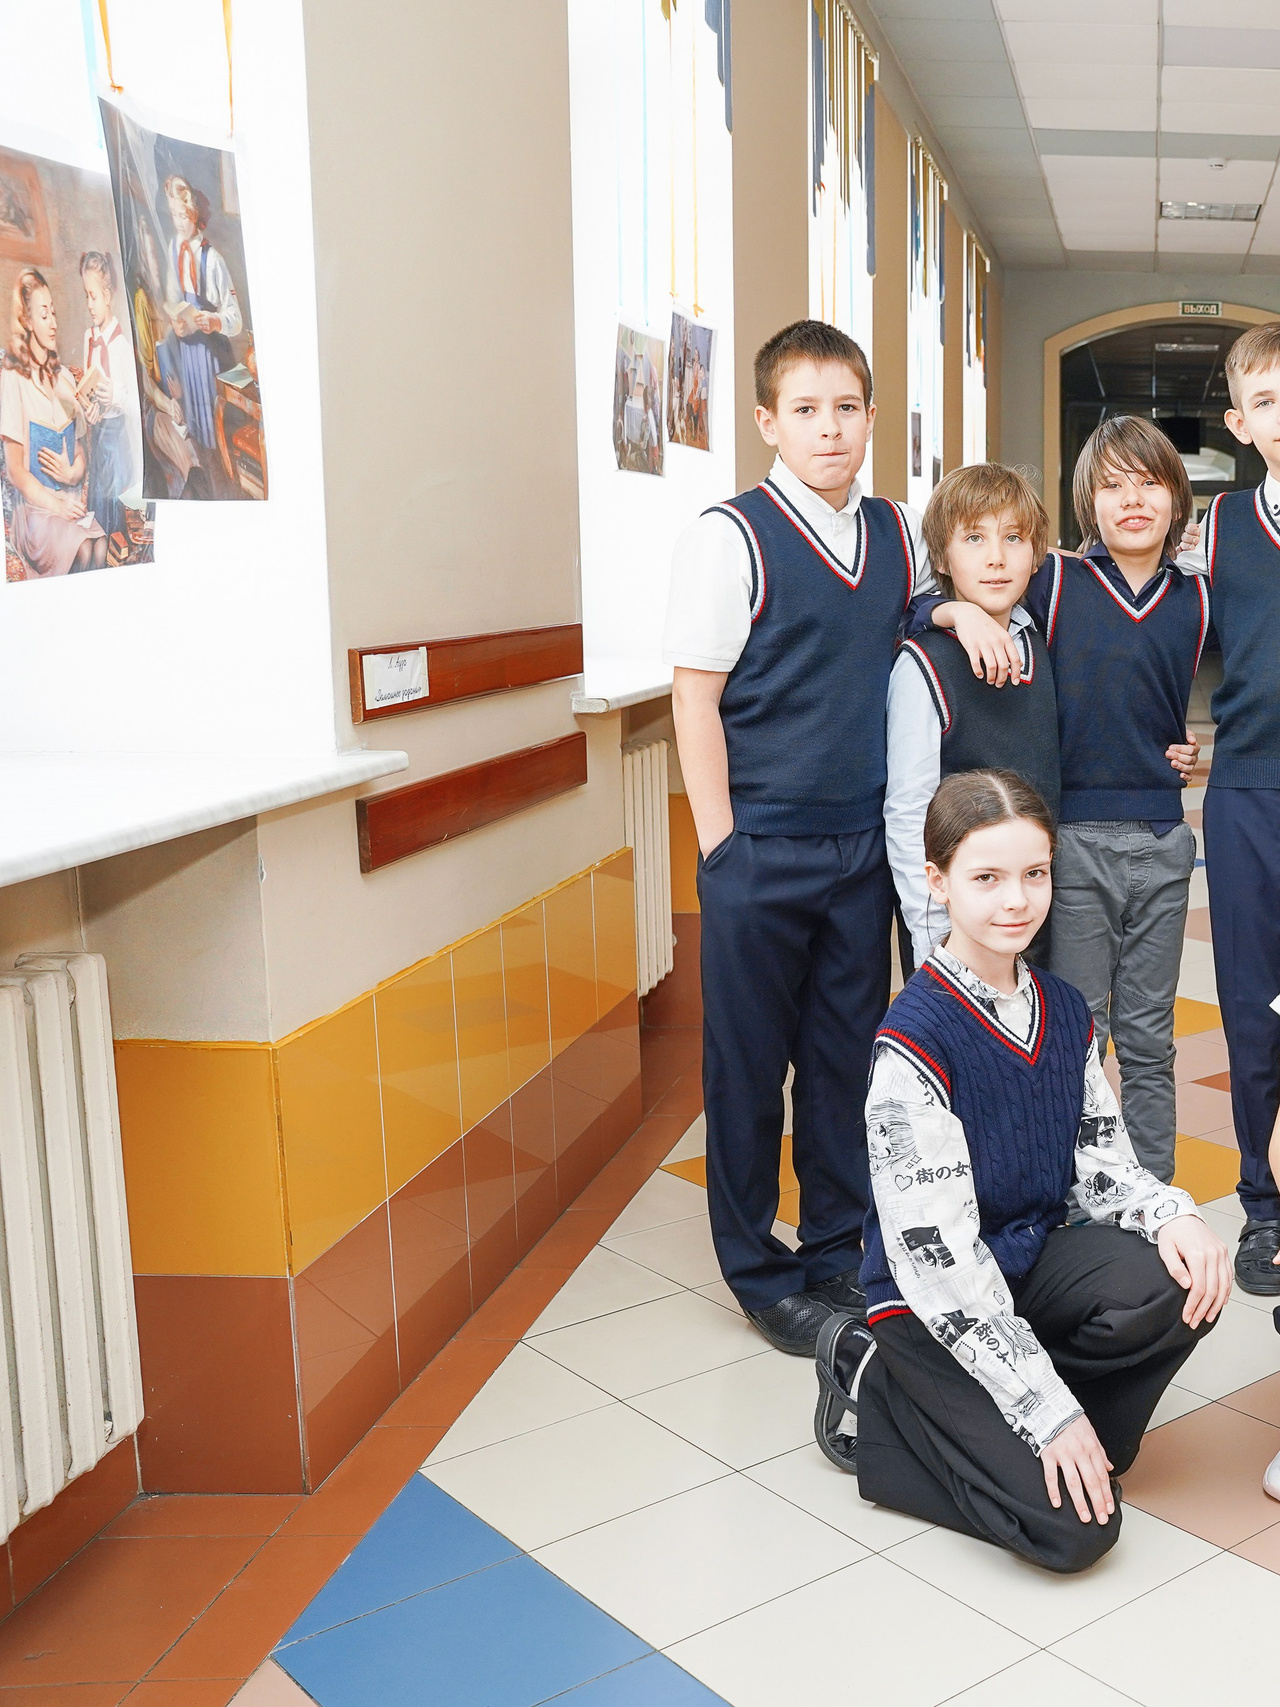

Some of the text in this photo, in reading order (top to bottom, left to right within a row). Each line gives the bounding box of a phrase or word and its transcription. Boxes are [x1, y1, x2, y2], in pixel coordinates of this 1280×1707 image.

[1184, 305, 1217, 315] ВЫХОД
[915, 1161, 971, 1185] 街の女
